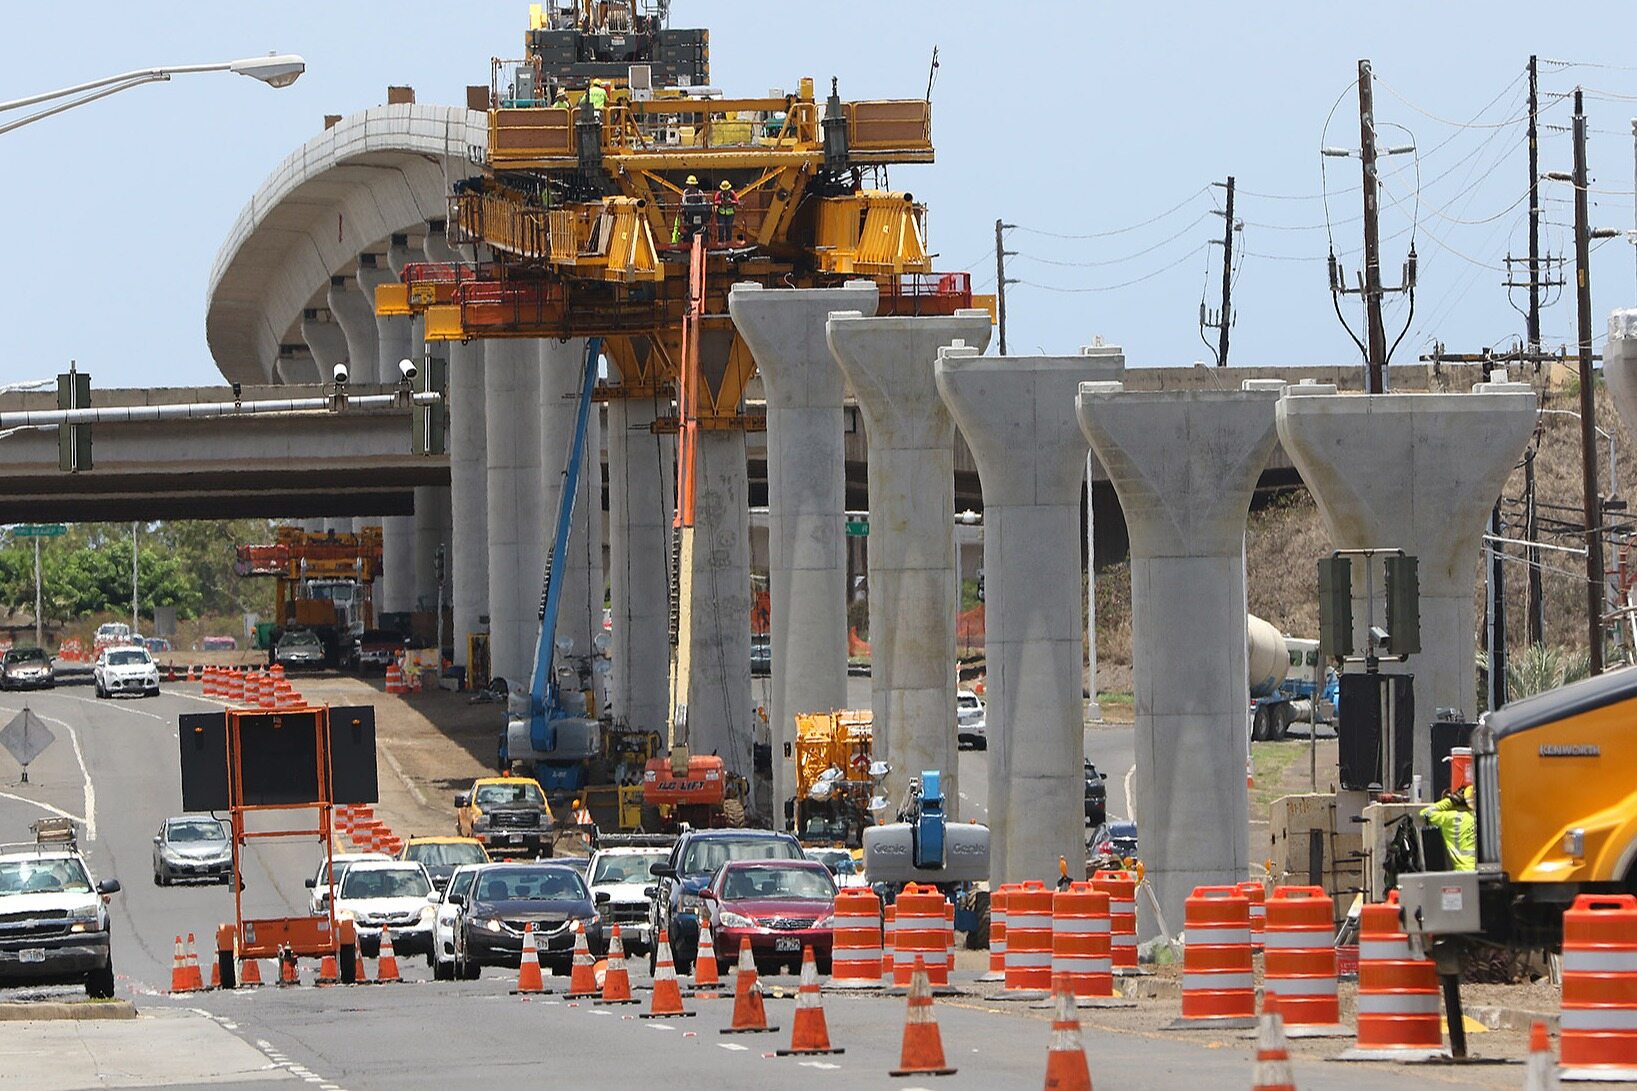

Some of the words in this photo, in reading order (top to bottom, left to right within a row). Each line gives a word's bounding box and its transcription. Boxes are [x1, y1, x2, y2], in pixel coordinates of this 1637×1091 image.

[1539, 744, 1600, 756] KENWORTH
[656, 781, 676, 791] JLG
[680, 781, 705, 791] LIFT
[873, 843, 906, 855] Genie
[953, 843, 986, 855] Genie
